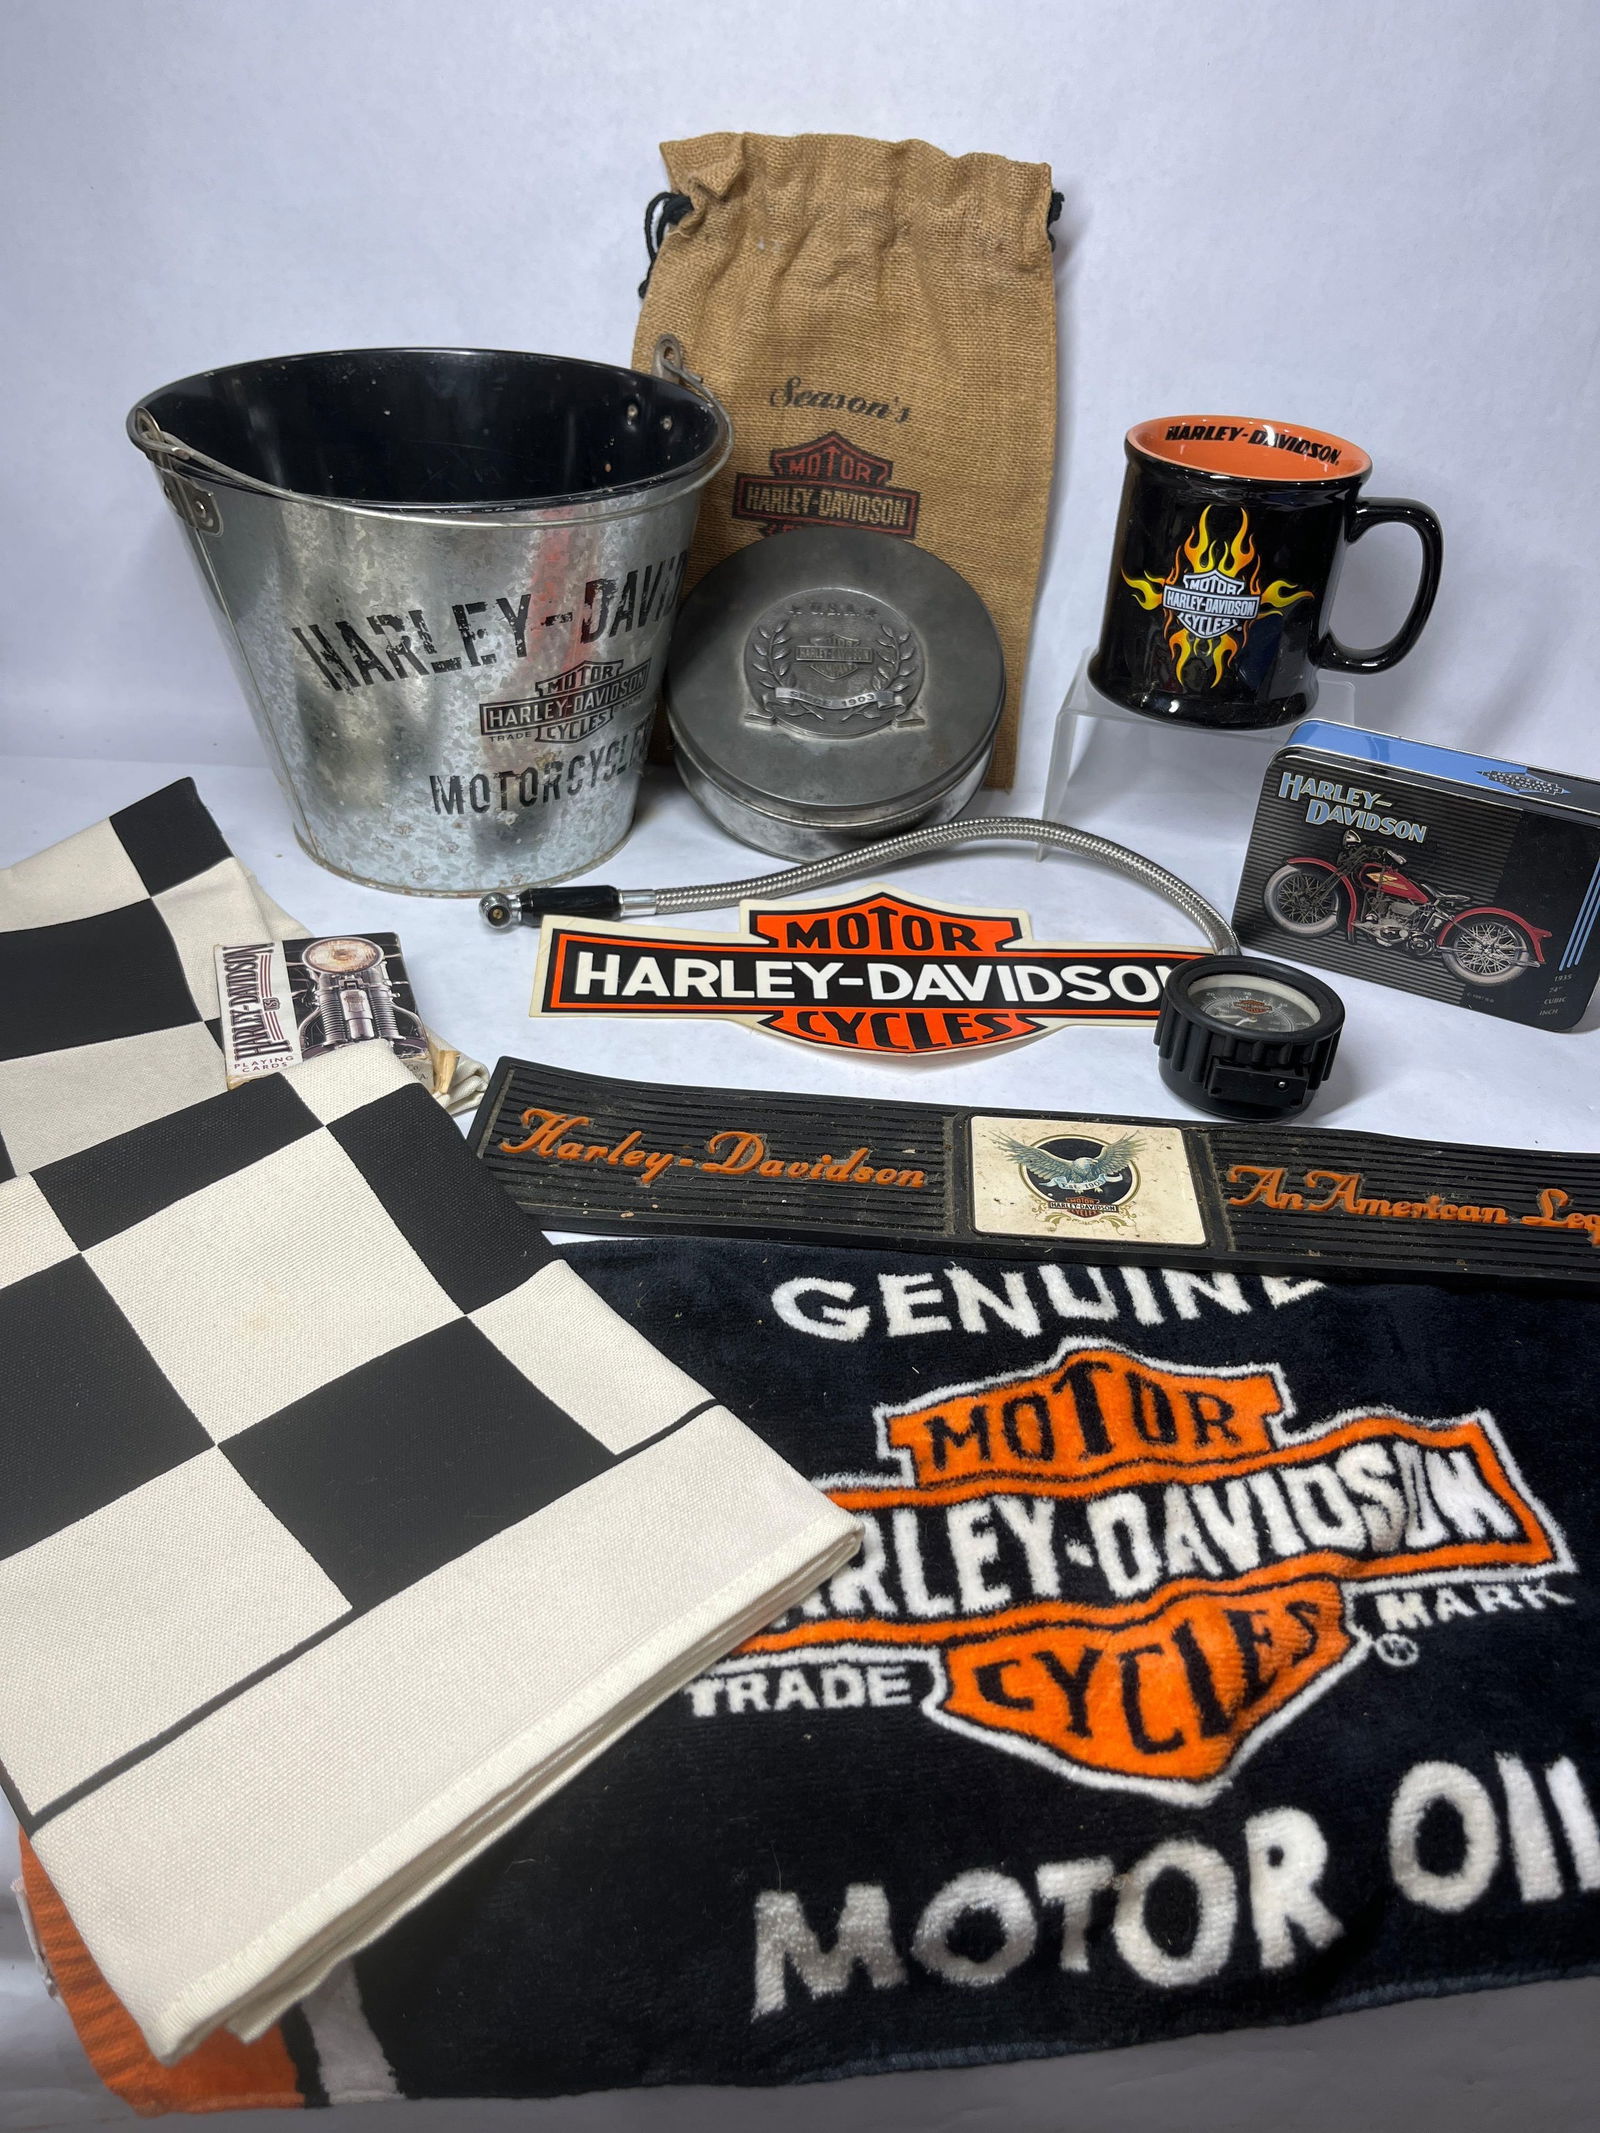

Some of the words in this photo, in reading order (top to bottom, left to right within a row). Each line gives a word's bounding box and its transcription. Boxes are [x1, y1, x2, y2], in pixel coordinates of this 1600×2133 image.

[769, 375, 911, 423] Season's
[789, 446, 872, 482] MOTOR
[746, 485, 909, 526] HARLEY-DAVIDSON
[1166, 590, 1256, 616] HARLEY-DAVIDSON
[1189, 574, 1237, 594] MOTOR
[1184, 613, 1231, 636] CYCLES
[488, 668, 648, 729] HARLEY-DAVIDSON
[548, 665, 617, 694] MOTOR
[841, 692, 876, 706] 1903
[488, 731, 531, 743] TRADE
[546, 712, 610, 741] CYCLES
[1305, 799, 1427, 843] DAVIDSON
[786, 907, 980, 952] MOTOR
[222, 942, 294, 1061] HARLEY-DAVIDSON
[795, 1008, 1018, 1049] CYCLES
[234, 1055, 294, 1069] PLAYING
[242, 1062, 288, 1073] CARDS
[501, 1108, 926, 1187] Harley-Davidson
[1050, 1202, 1116, 1211] HARLEY-DAVIDSON
[1228, 1165, 1304, 1206] An
[1306, 1170, 1510, 1225] American
[922, 1361, 1245, 1474] MOTOR
[1375, 1579, 1575, 1631] MARK
[685, 1664, 914, 1718] TRADE
[974, 1600, 1322, 1755] CYCLES
[749, 1806, 1344, 2025] MOTOR
